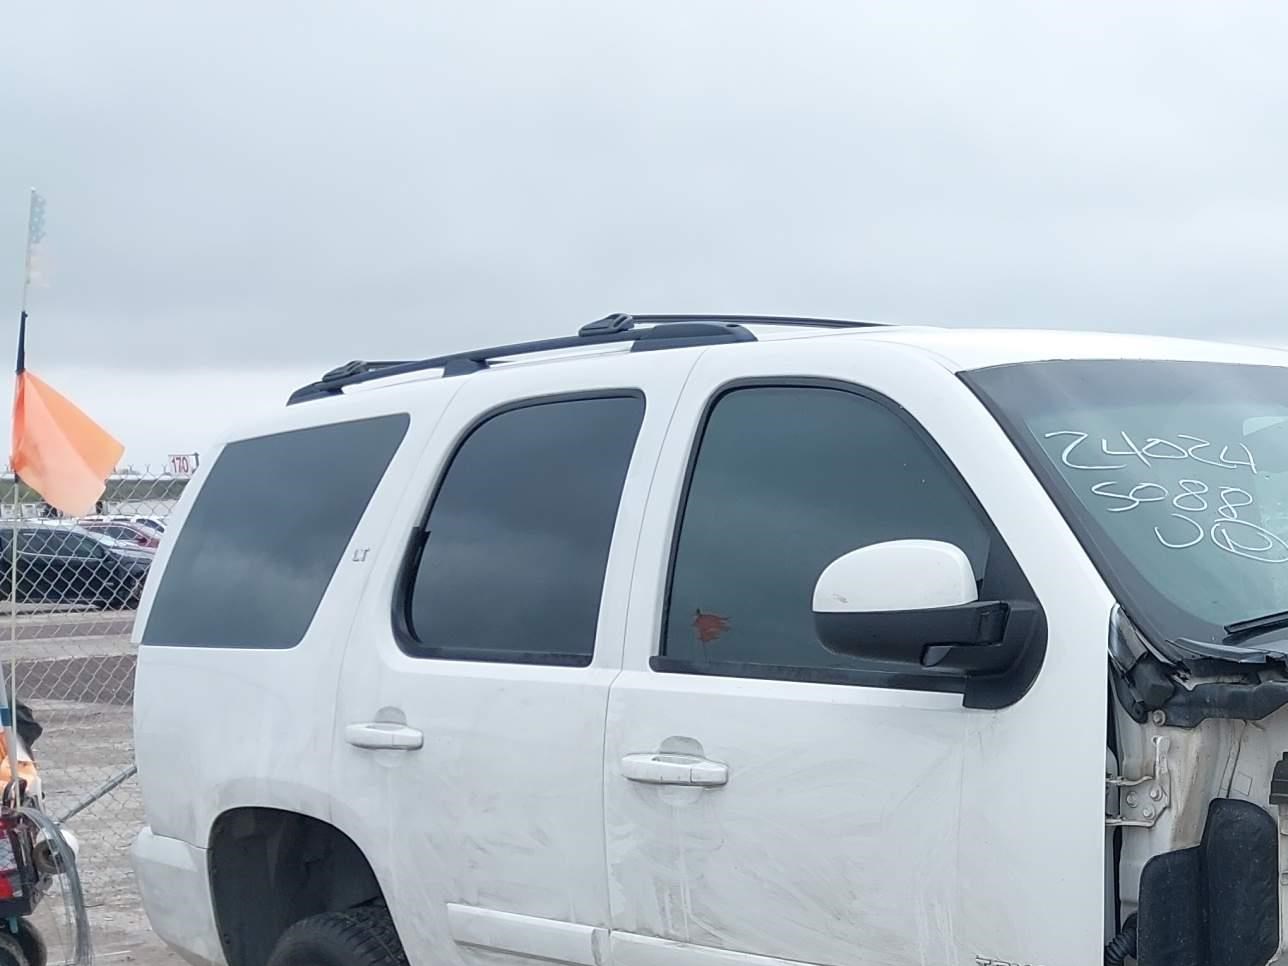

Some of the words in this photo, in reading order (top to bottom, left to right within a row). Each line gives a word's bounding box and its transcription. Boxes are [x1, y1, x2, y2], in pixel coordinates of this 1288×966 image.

[1045, 431, 1257, 474] 24024
[172, 457, 188, 473] 170
[352, 548, 370, 562] LT
